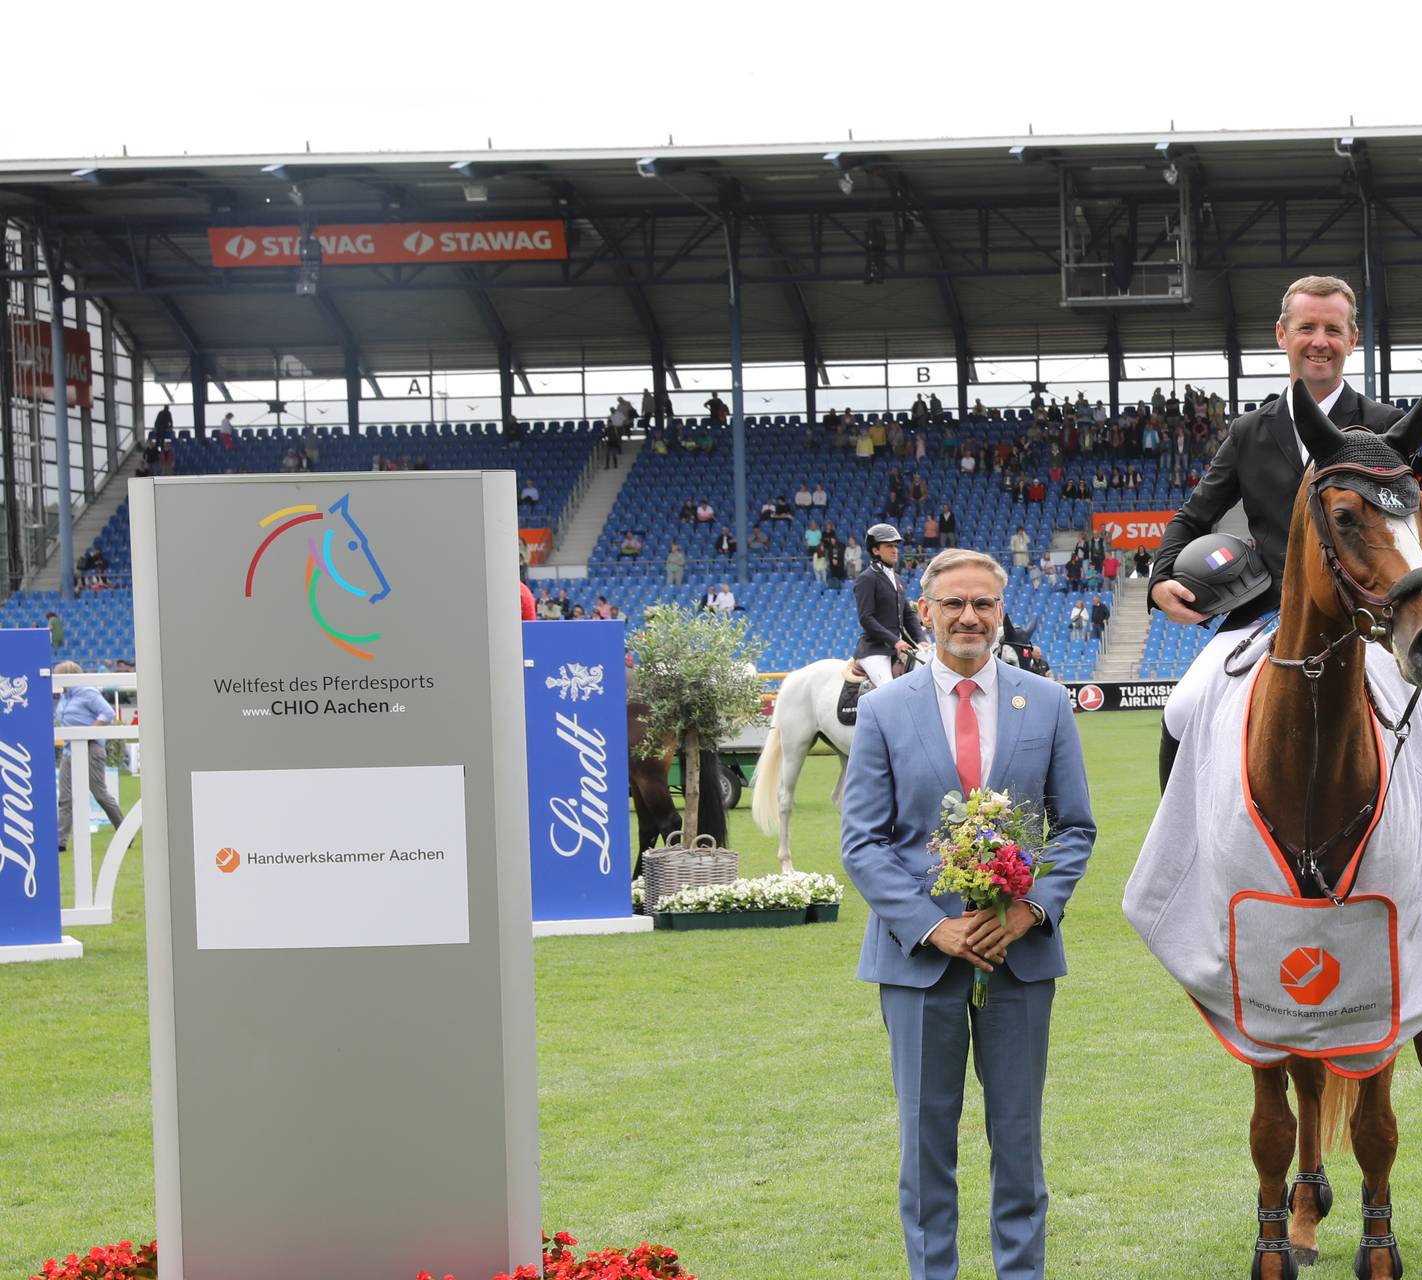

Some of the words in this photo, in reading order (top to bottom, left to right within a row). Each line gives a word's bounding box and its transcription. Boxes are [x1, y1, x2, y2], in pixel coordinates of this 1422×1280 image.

[440, 230, 552, 252] STAWAG
[917, 367, 930, 383] B
[408, 379, 422, 395] A
[214, 677, 285, 694] Weltfest
[289, 676, 318, 692] des
[323, 674, 435, 692] Pferdesports
[1119, 685, 1176, 697] TURKISH
[1119, 696, 1168, 708] AIRLINE
[550, 711, 611, 875] Lindt
[247, 850, 386, 865] Handwerkskammer
[389, 848, 445, 862] Aachen
[1248, 998, 1339, 1018] Handwerkskammer
[1340, 1002, 1377, 1015] Aachen
